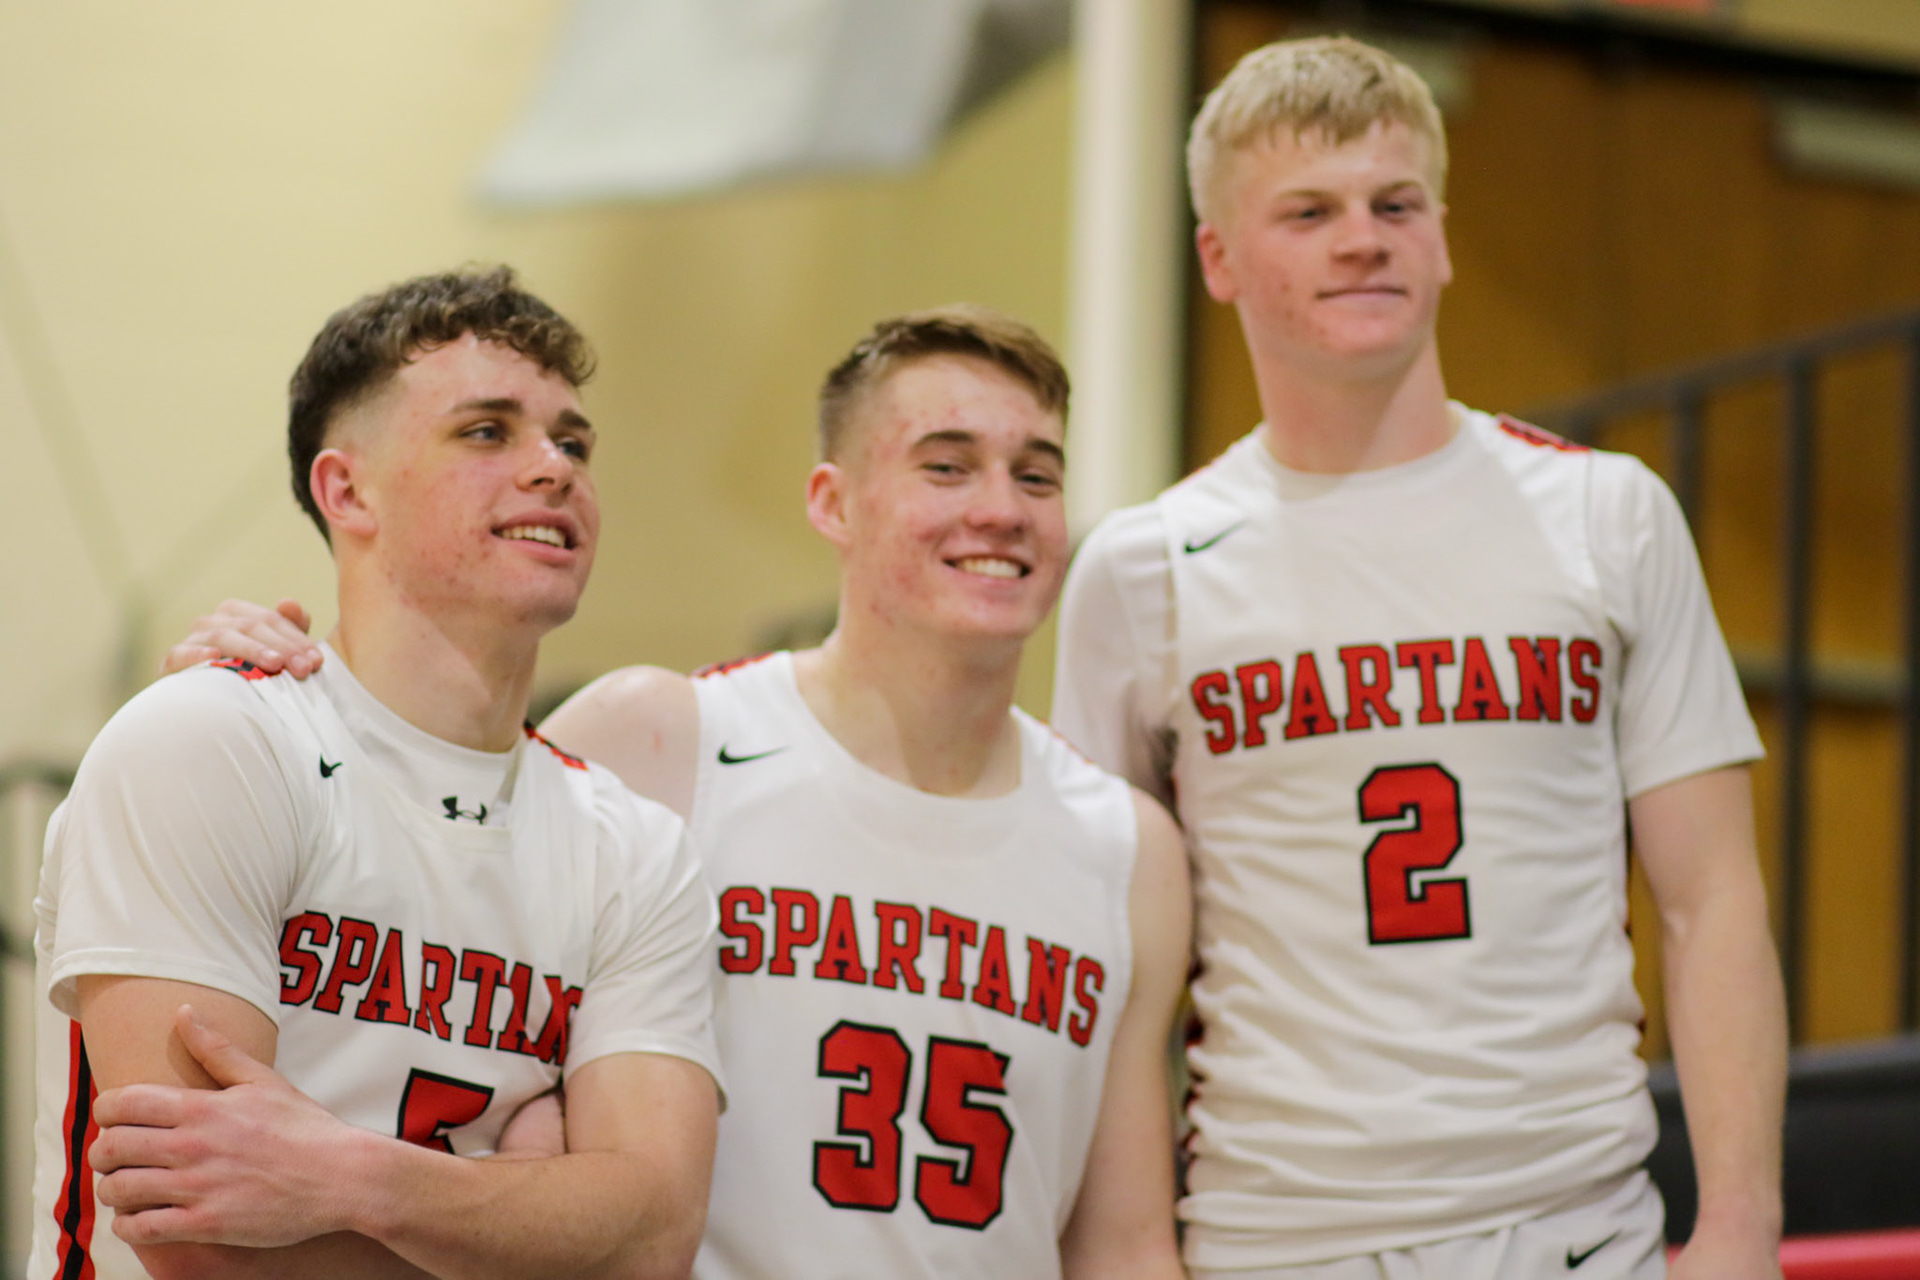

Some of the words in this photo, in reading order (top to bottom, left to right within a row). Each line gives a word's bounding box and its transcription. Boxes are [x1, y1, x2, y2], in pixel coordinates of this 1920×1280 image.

[1192, 636, 1602, 753] SPARTANS
[1357, 762, 1472, 946] 2
[279, 909, 584, 1068] SPARTAN
[719, 886, 1106, 1048] SPARTANS
[813, 1020, 1013, 1231] 35
